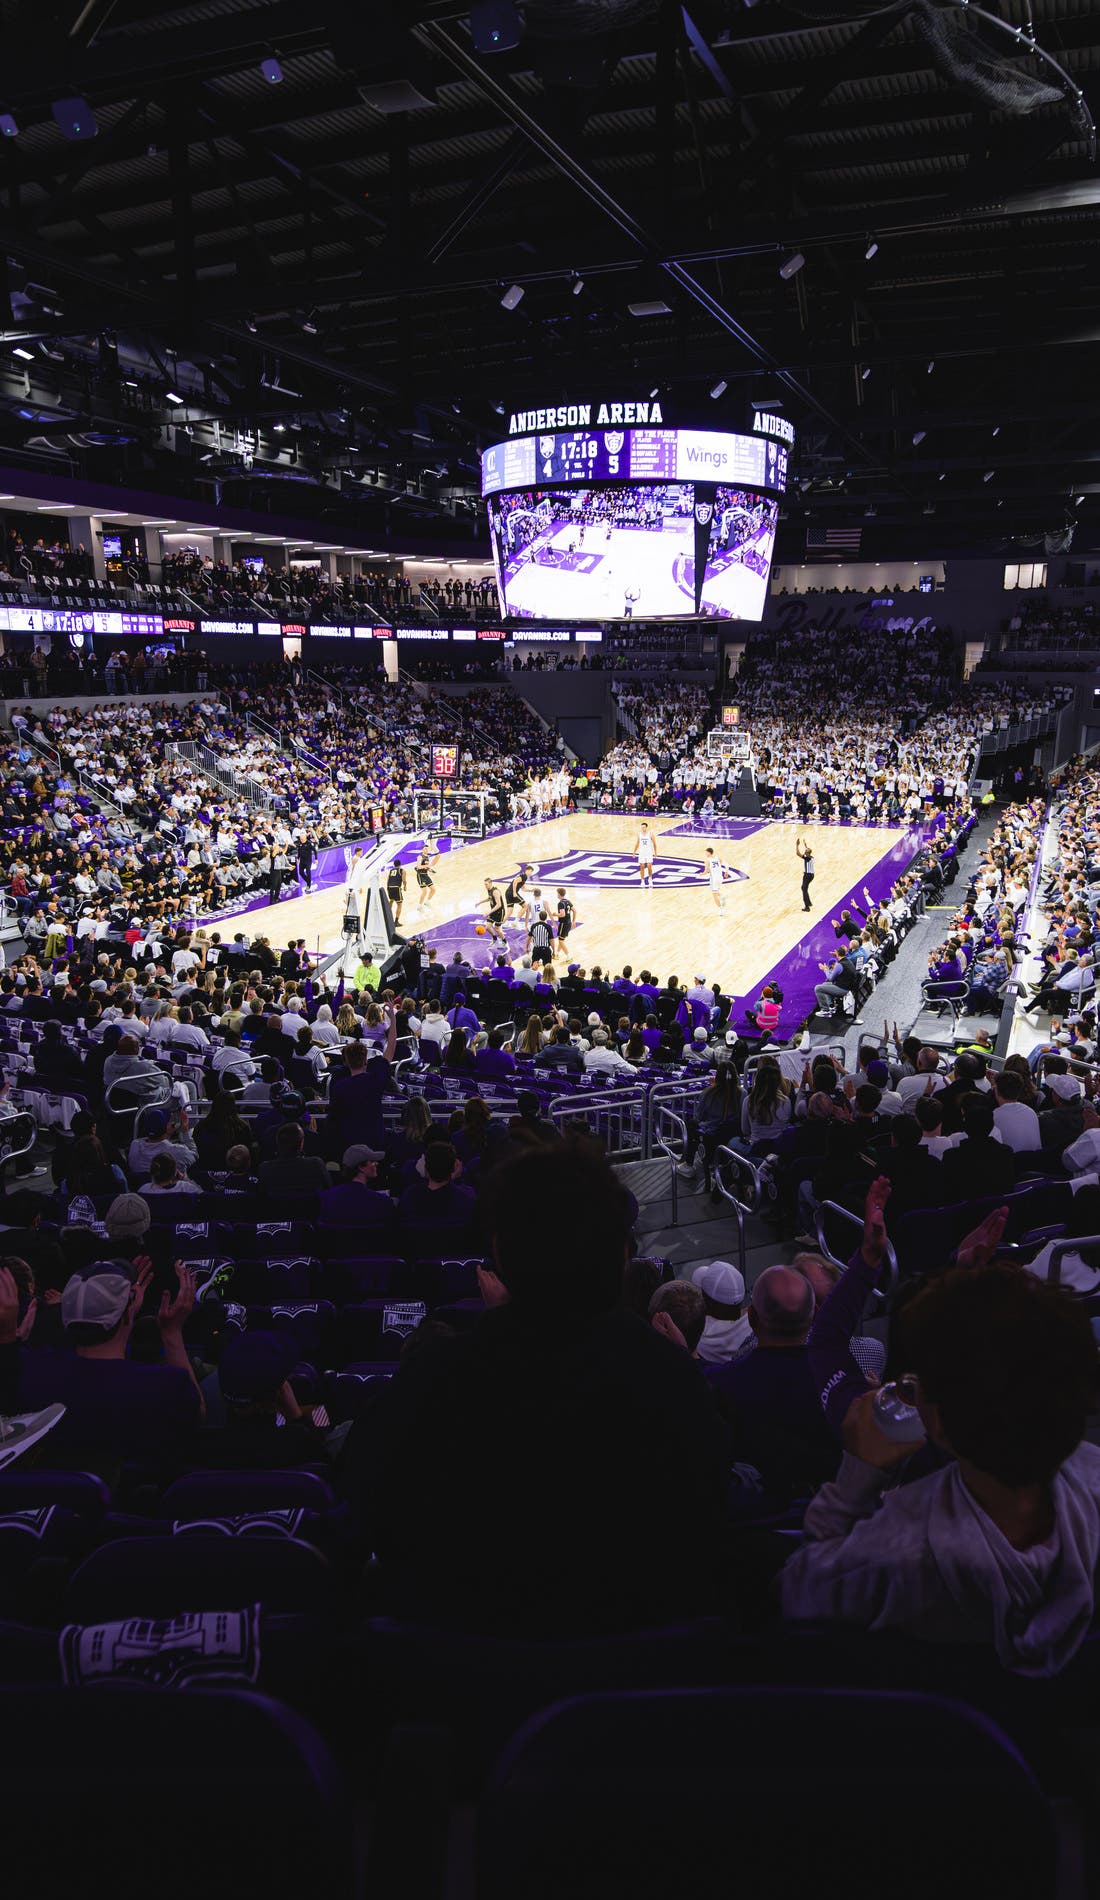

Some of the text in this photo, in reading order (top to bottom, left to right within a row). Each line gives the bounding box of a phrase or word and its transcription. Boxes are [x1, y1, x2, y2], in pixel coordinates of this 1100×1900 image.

[509, 402, 663, 434] ANDERSON ARENA
[561, 441, 598, 460] 17:18
[686, 447, 728, 468] Wings
[543, 459, 552, 477] 4
[608, 455, 619, 473] 5
[769, 466, 775, 483] 4
[28, 615, 34, 629] 4
[56, 616, 83, 631] 17:18
[201, 621, 254, 634] DAVANNIS.COM
[310, 626, 351, 637] DAVANNIS.COM
[397, 629, 449, 640] DAVANNIS.COM
[513, 631, 570, 641] DAVANNIS.COM
[534, 904, 541, 912] 12
